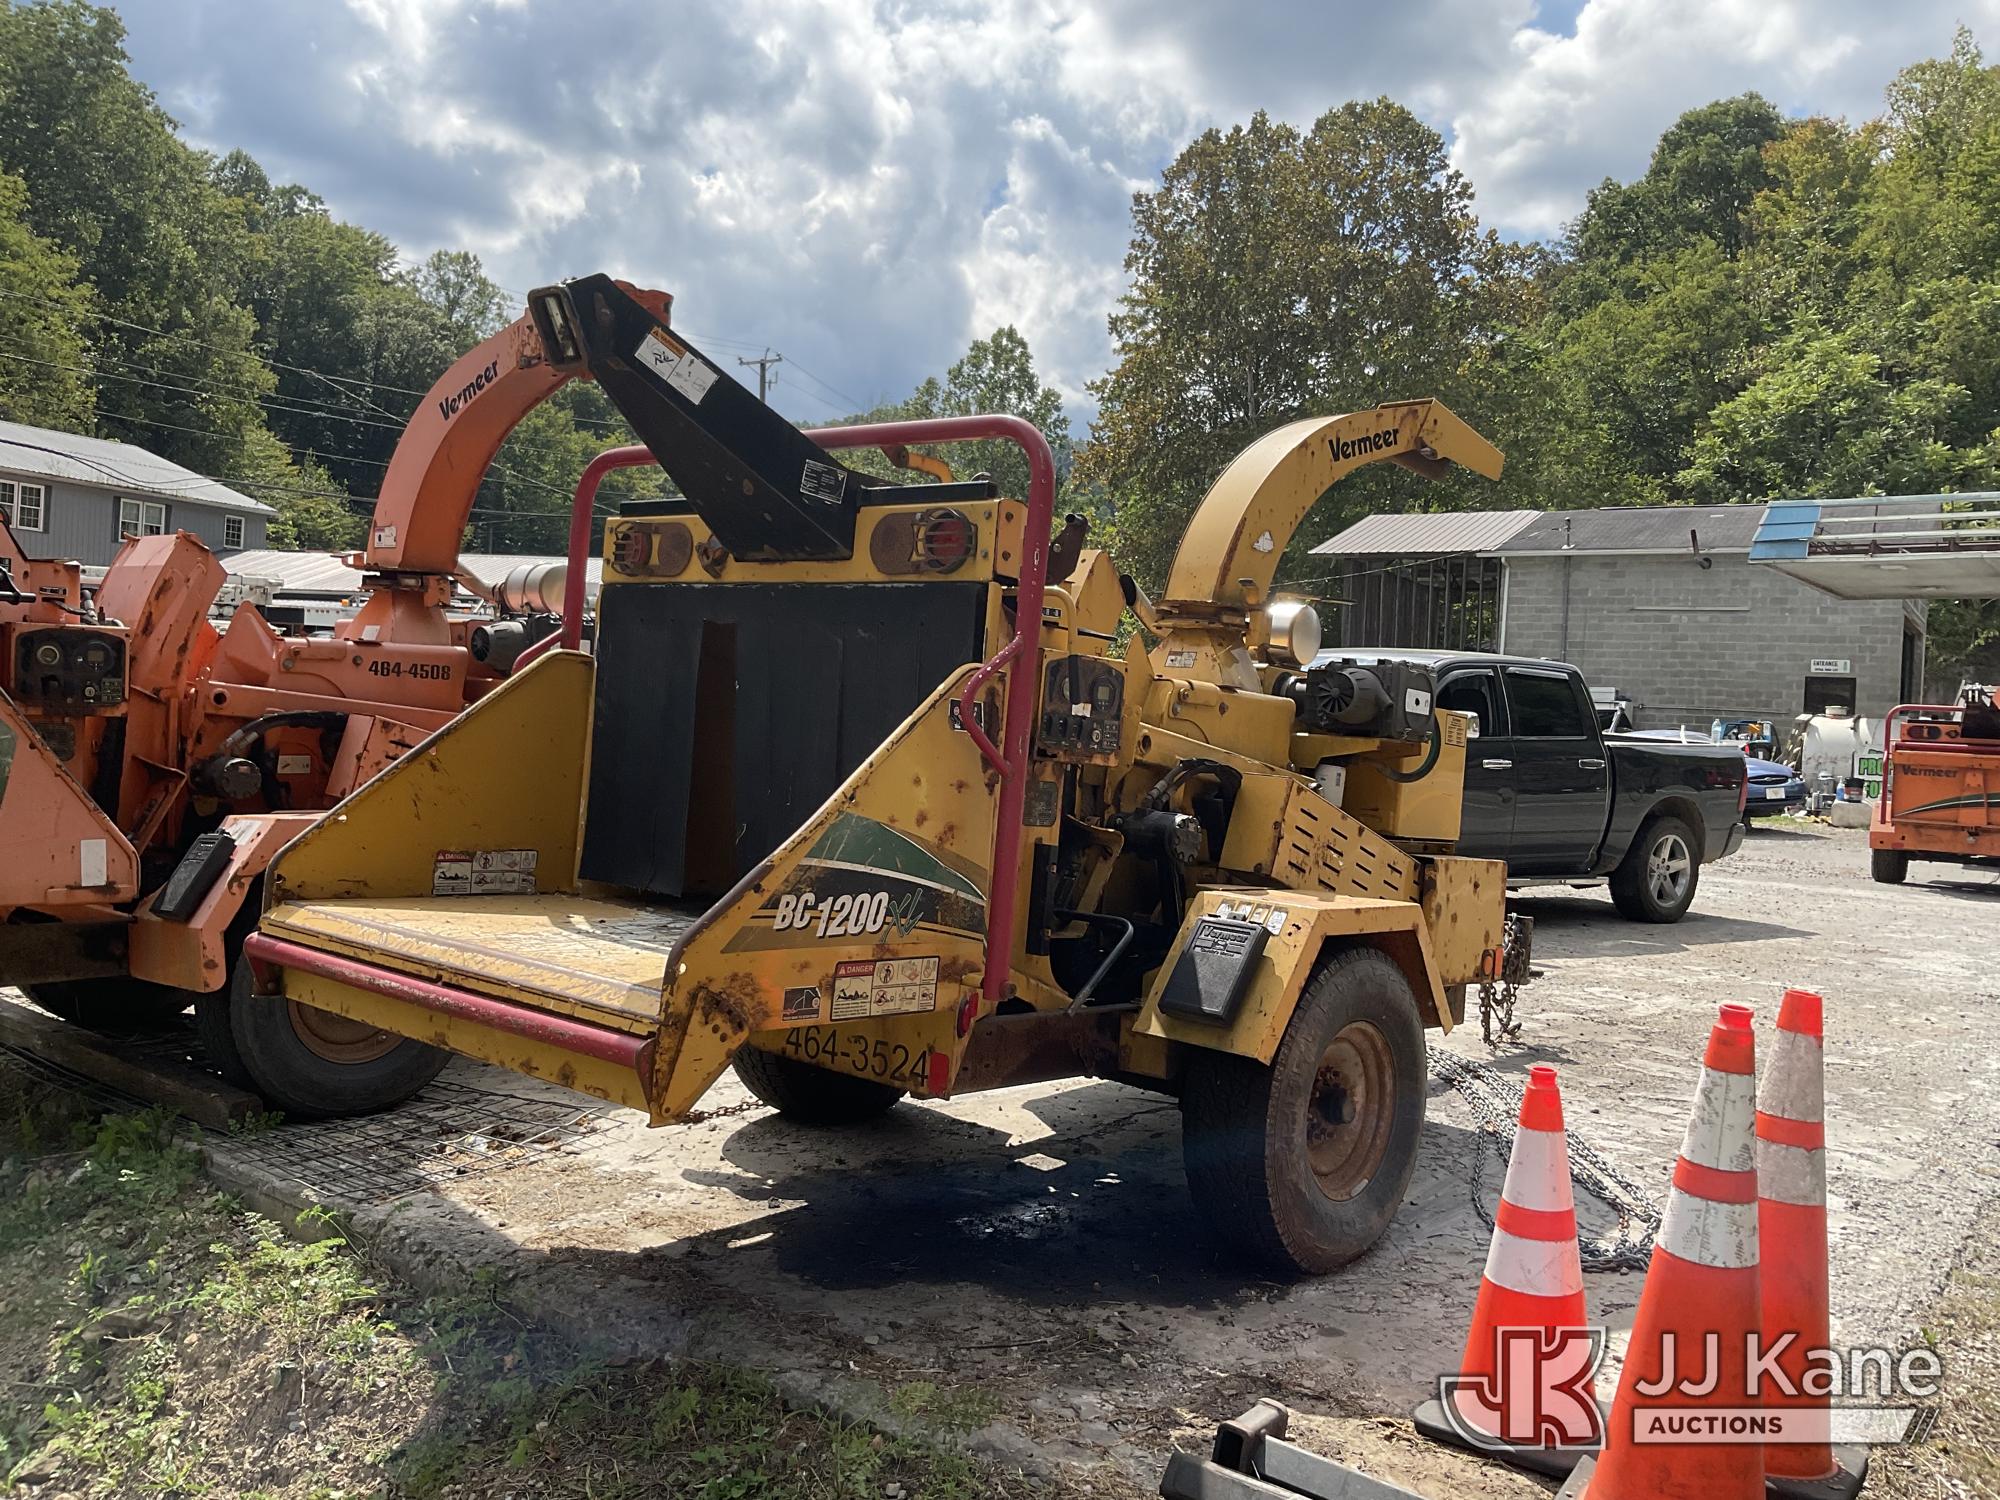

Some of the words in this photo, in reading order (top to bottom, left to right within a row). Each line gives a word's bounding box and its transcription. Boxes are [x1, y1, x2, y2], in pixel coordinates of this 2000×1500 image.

[438, 360, 498, 421] Vermeer
[1328, 428, 1399, 462] Vermeer
[1902, 765, 1958, 778] Vermeer
[773, 892, 816, 931] BC
[816, 891, 889, 938] 1200
[1203, 926, 1248, 943] Vermeer
[846, 964, 874, 974] DANGER
[786, 1025, 928, 1087] 464-3524
